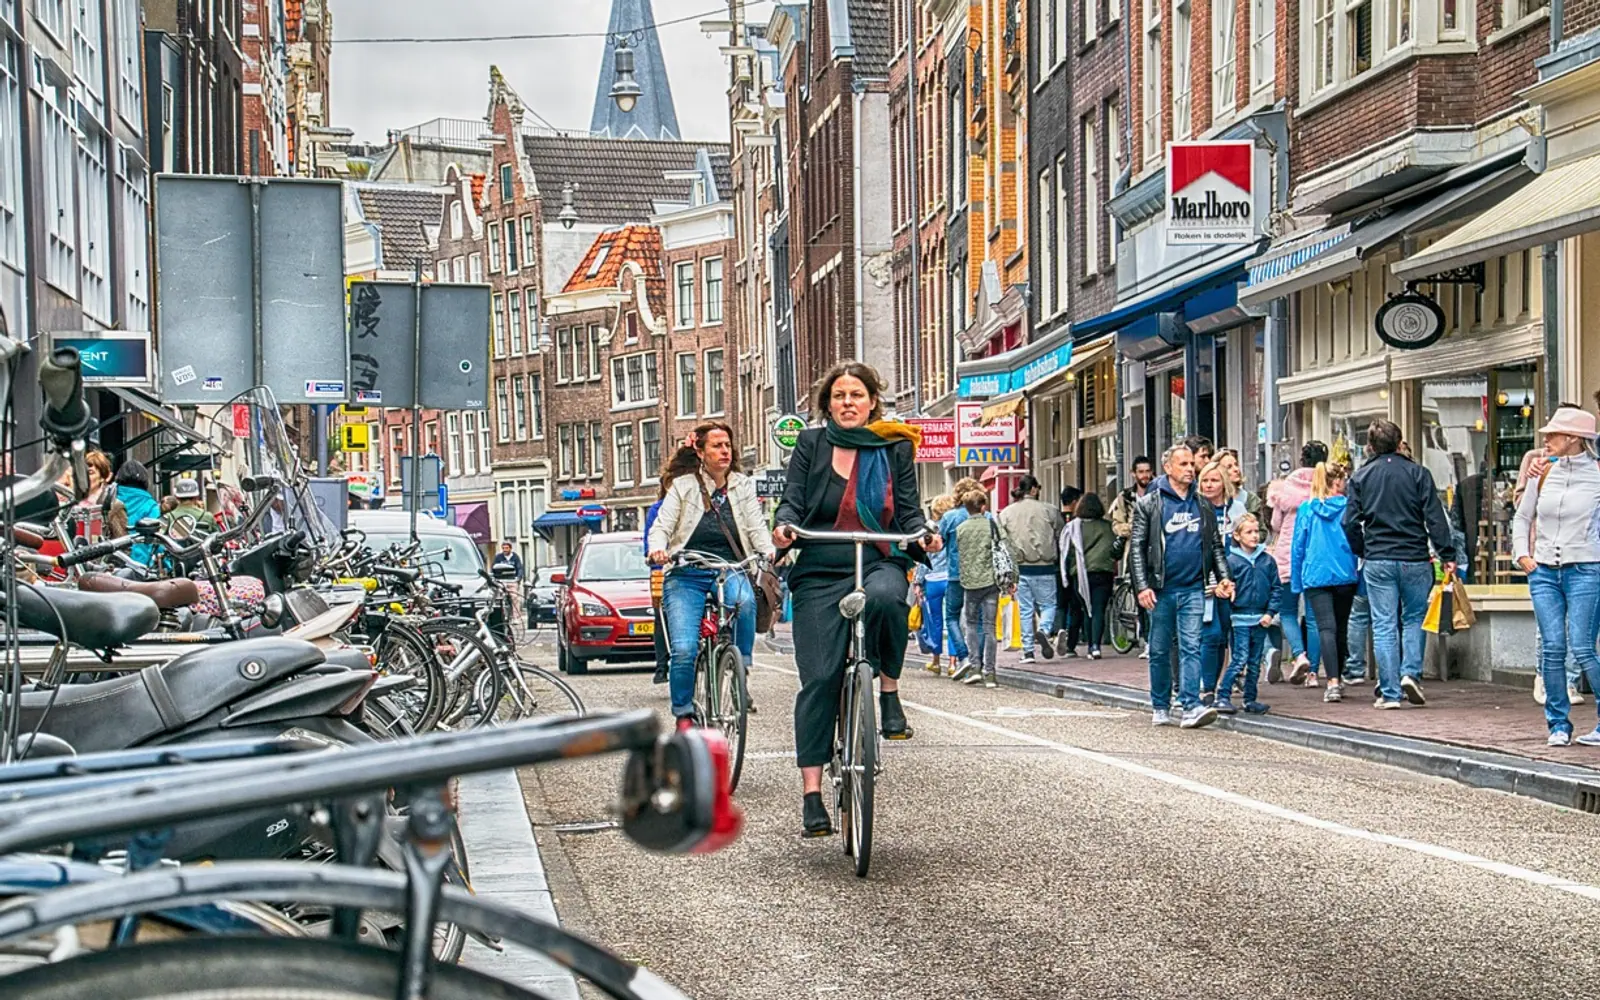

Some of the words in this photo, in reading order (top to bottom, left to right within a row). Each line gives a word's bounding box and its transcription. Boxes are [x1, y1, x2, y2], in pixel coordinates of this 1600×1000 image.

[1172, 190, 1250, 220] Marlboro
[1213, 232, 1247, 240] dodelijk
[924, 435, 948, 445] TABAK
[916, 446, 955, 458] SOUVENIRS
[965, 448, 1011, 461] ATM
